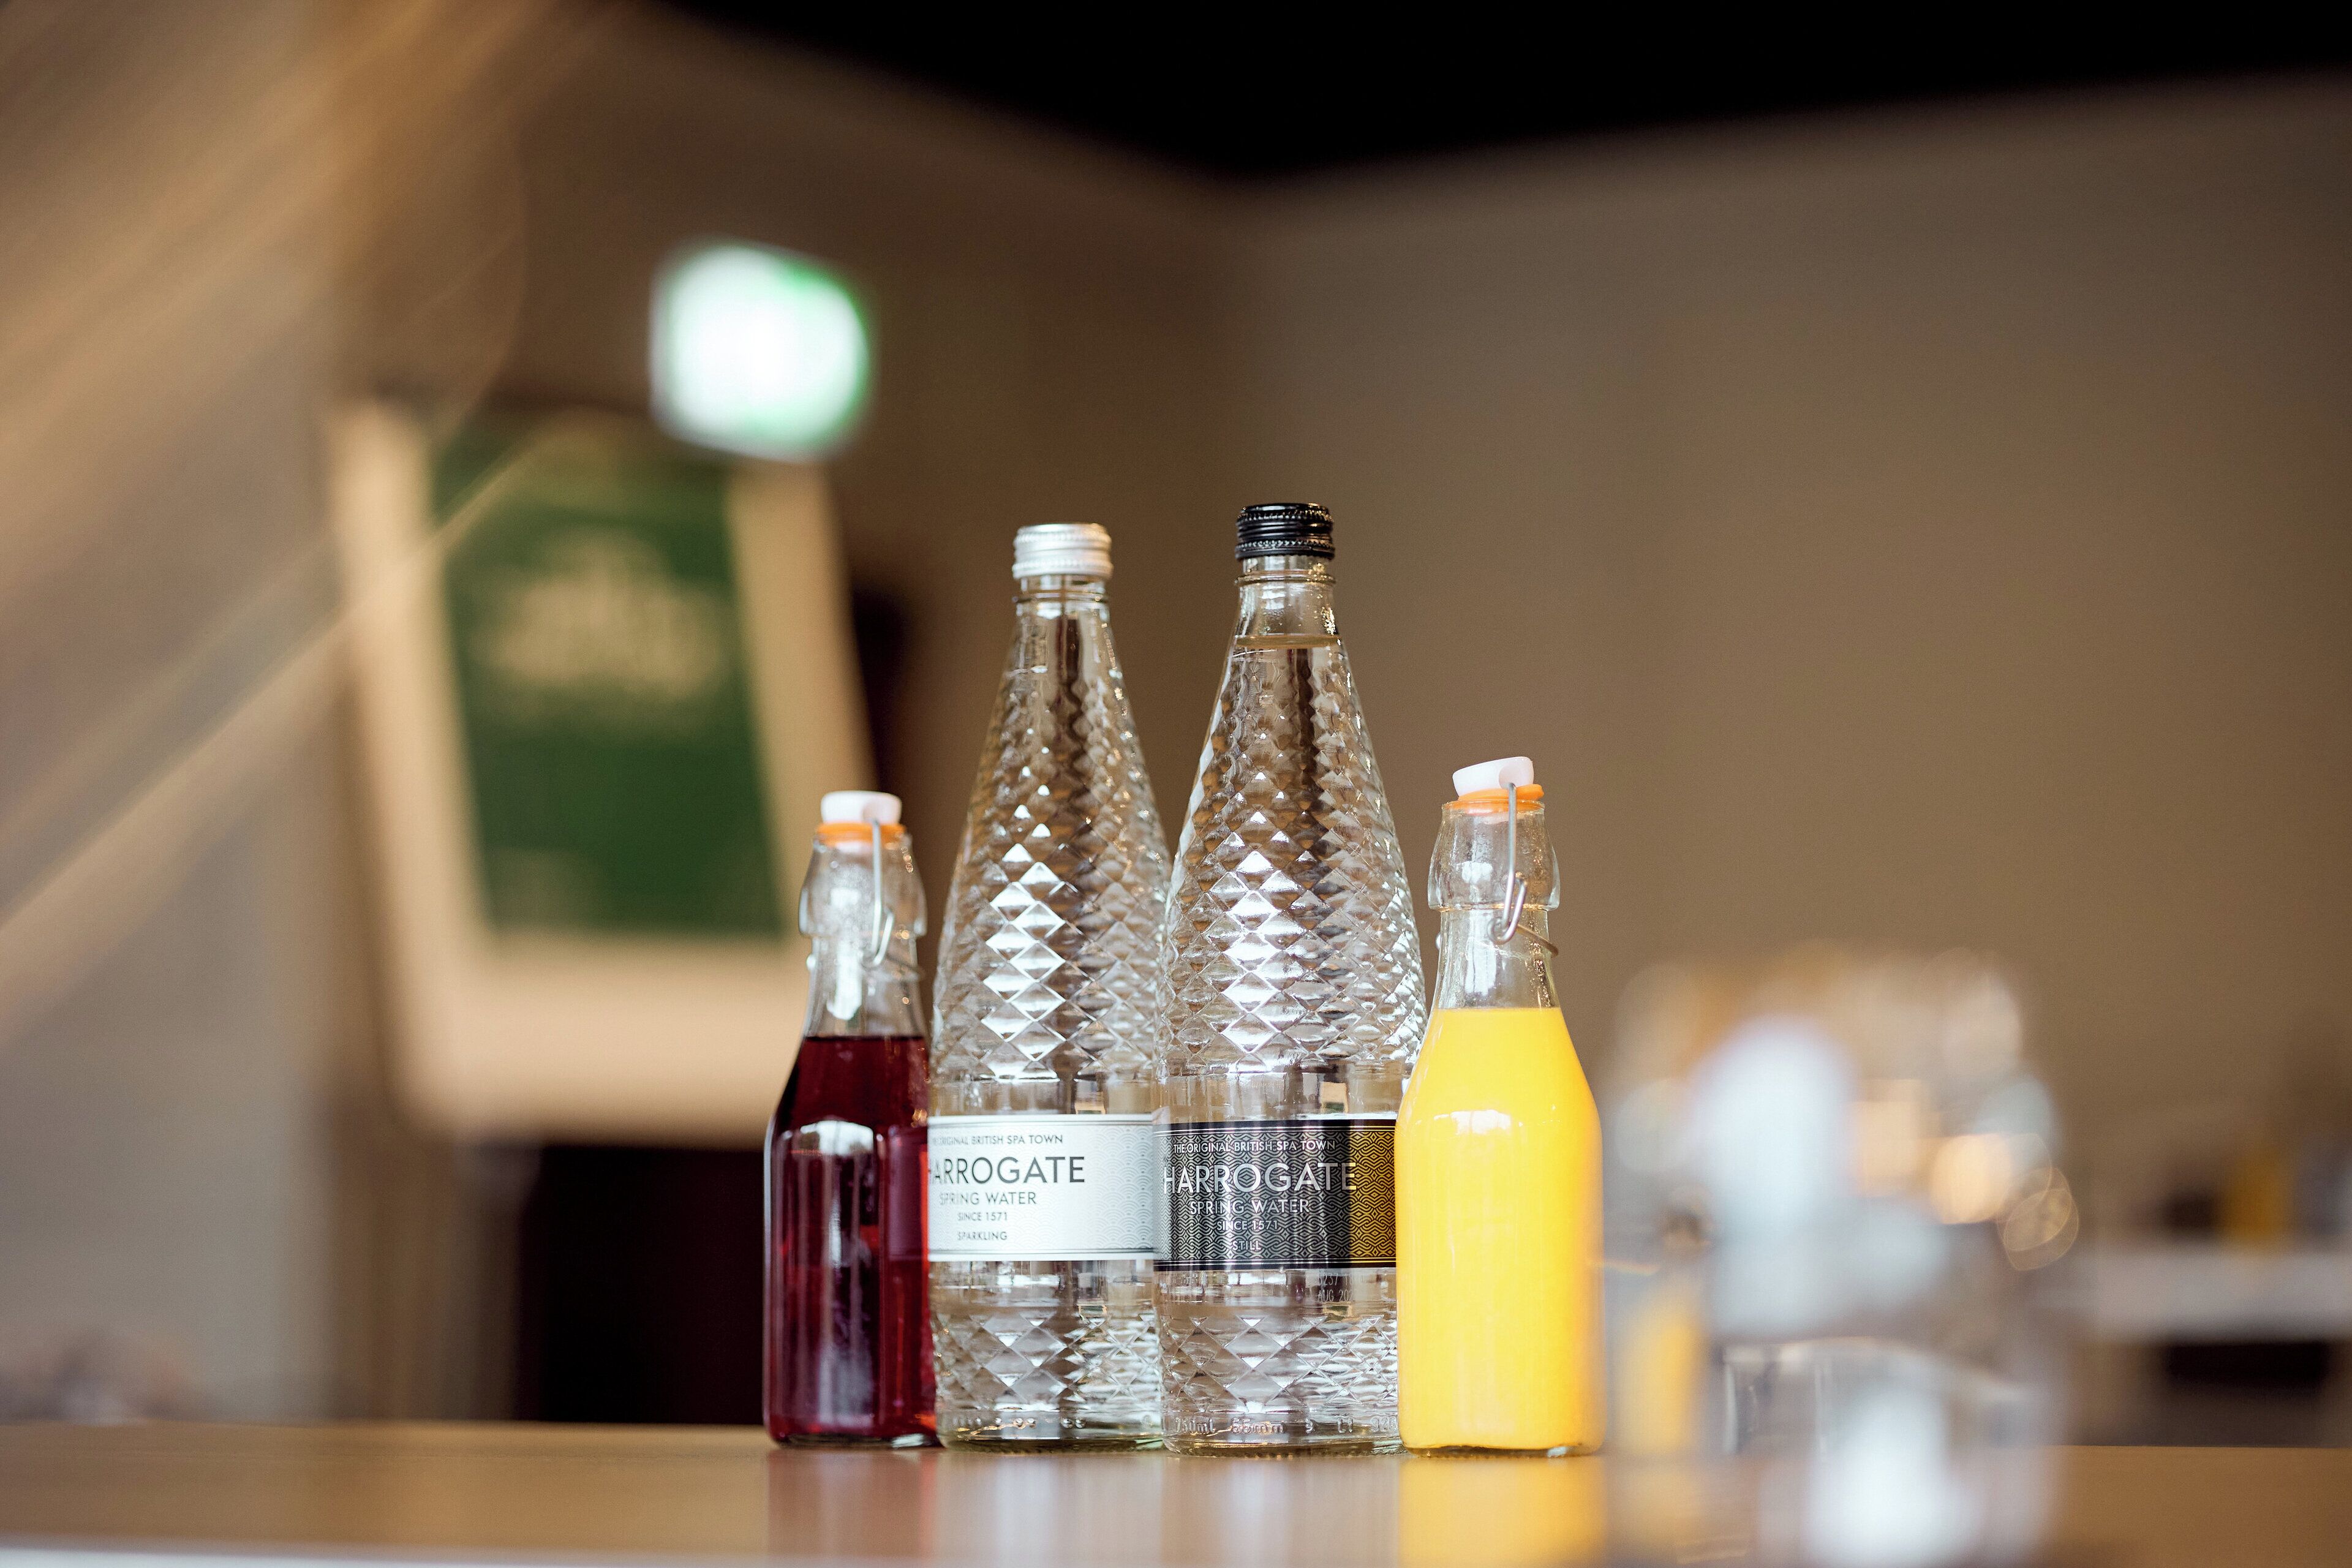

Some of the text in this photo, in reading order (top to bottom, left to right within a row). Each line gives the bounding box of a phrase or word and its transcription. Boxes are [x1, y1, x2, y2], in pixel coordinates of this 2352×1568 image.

[971, 1136, 1003, 1145] BRITISH
[1007, 1135, 1025, 1144] SPA
[1029, 1134, 1063, 1144] TOWN
[1174, 1140, 1335, 1153] THE ORIGINAL BRITISH SPA TOWN
[1164, 1162, 1357, 1194] HARROGATE
[940, 1191, 1036, 1205] SPRING WATER
[1190, 1199, 1310, 1215] SPRING WATER
[957, 1212, 1008, 1221] SINCE 1571
[1217, 1220, 1278, 1231] SINCE 1571
[957, 1231, 1008, 1240] SPARKLING
[1232, 1240, 1261, 1251] STILL
